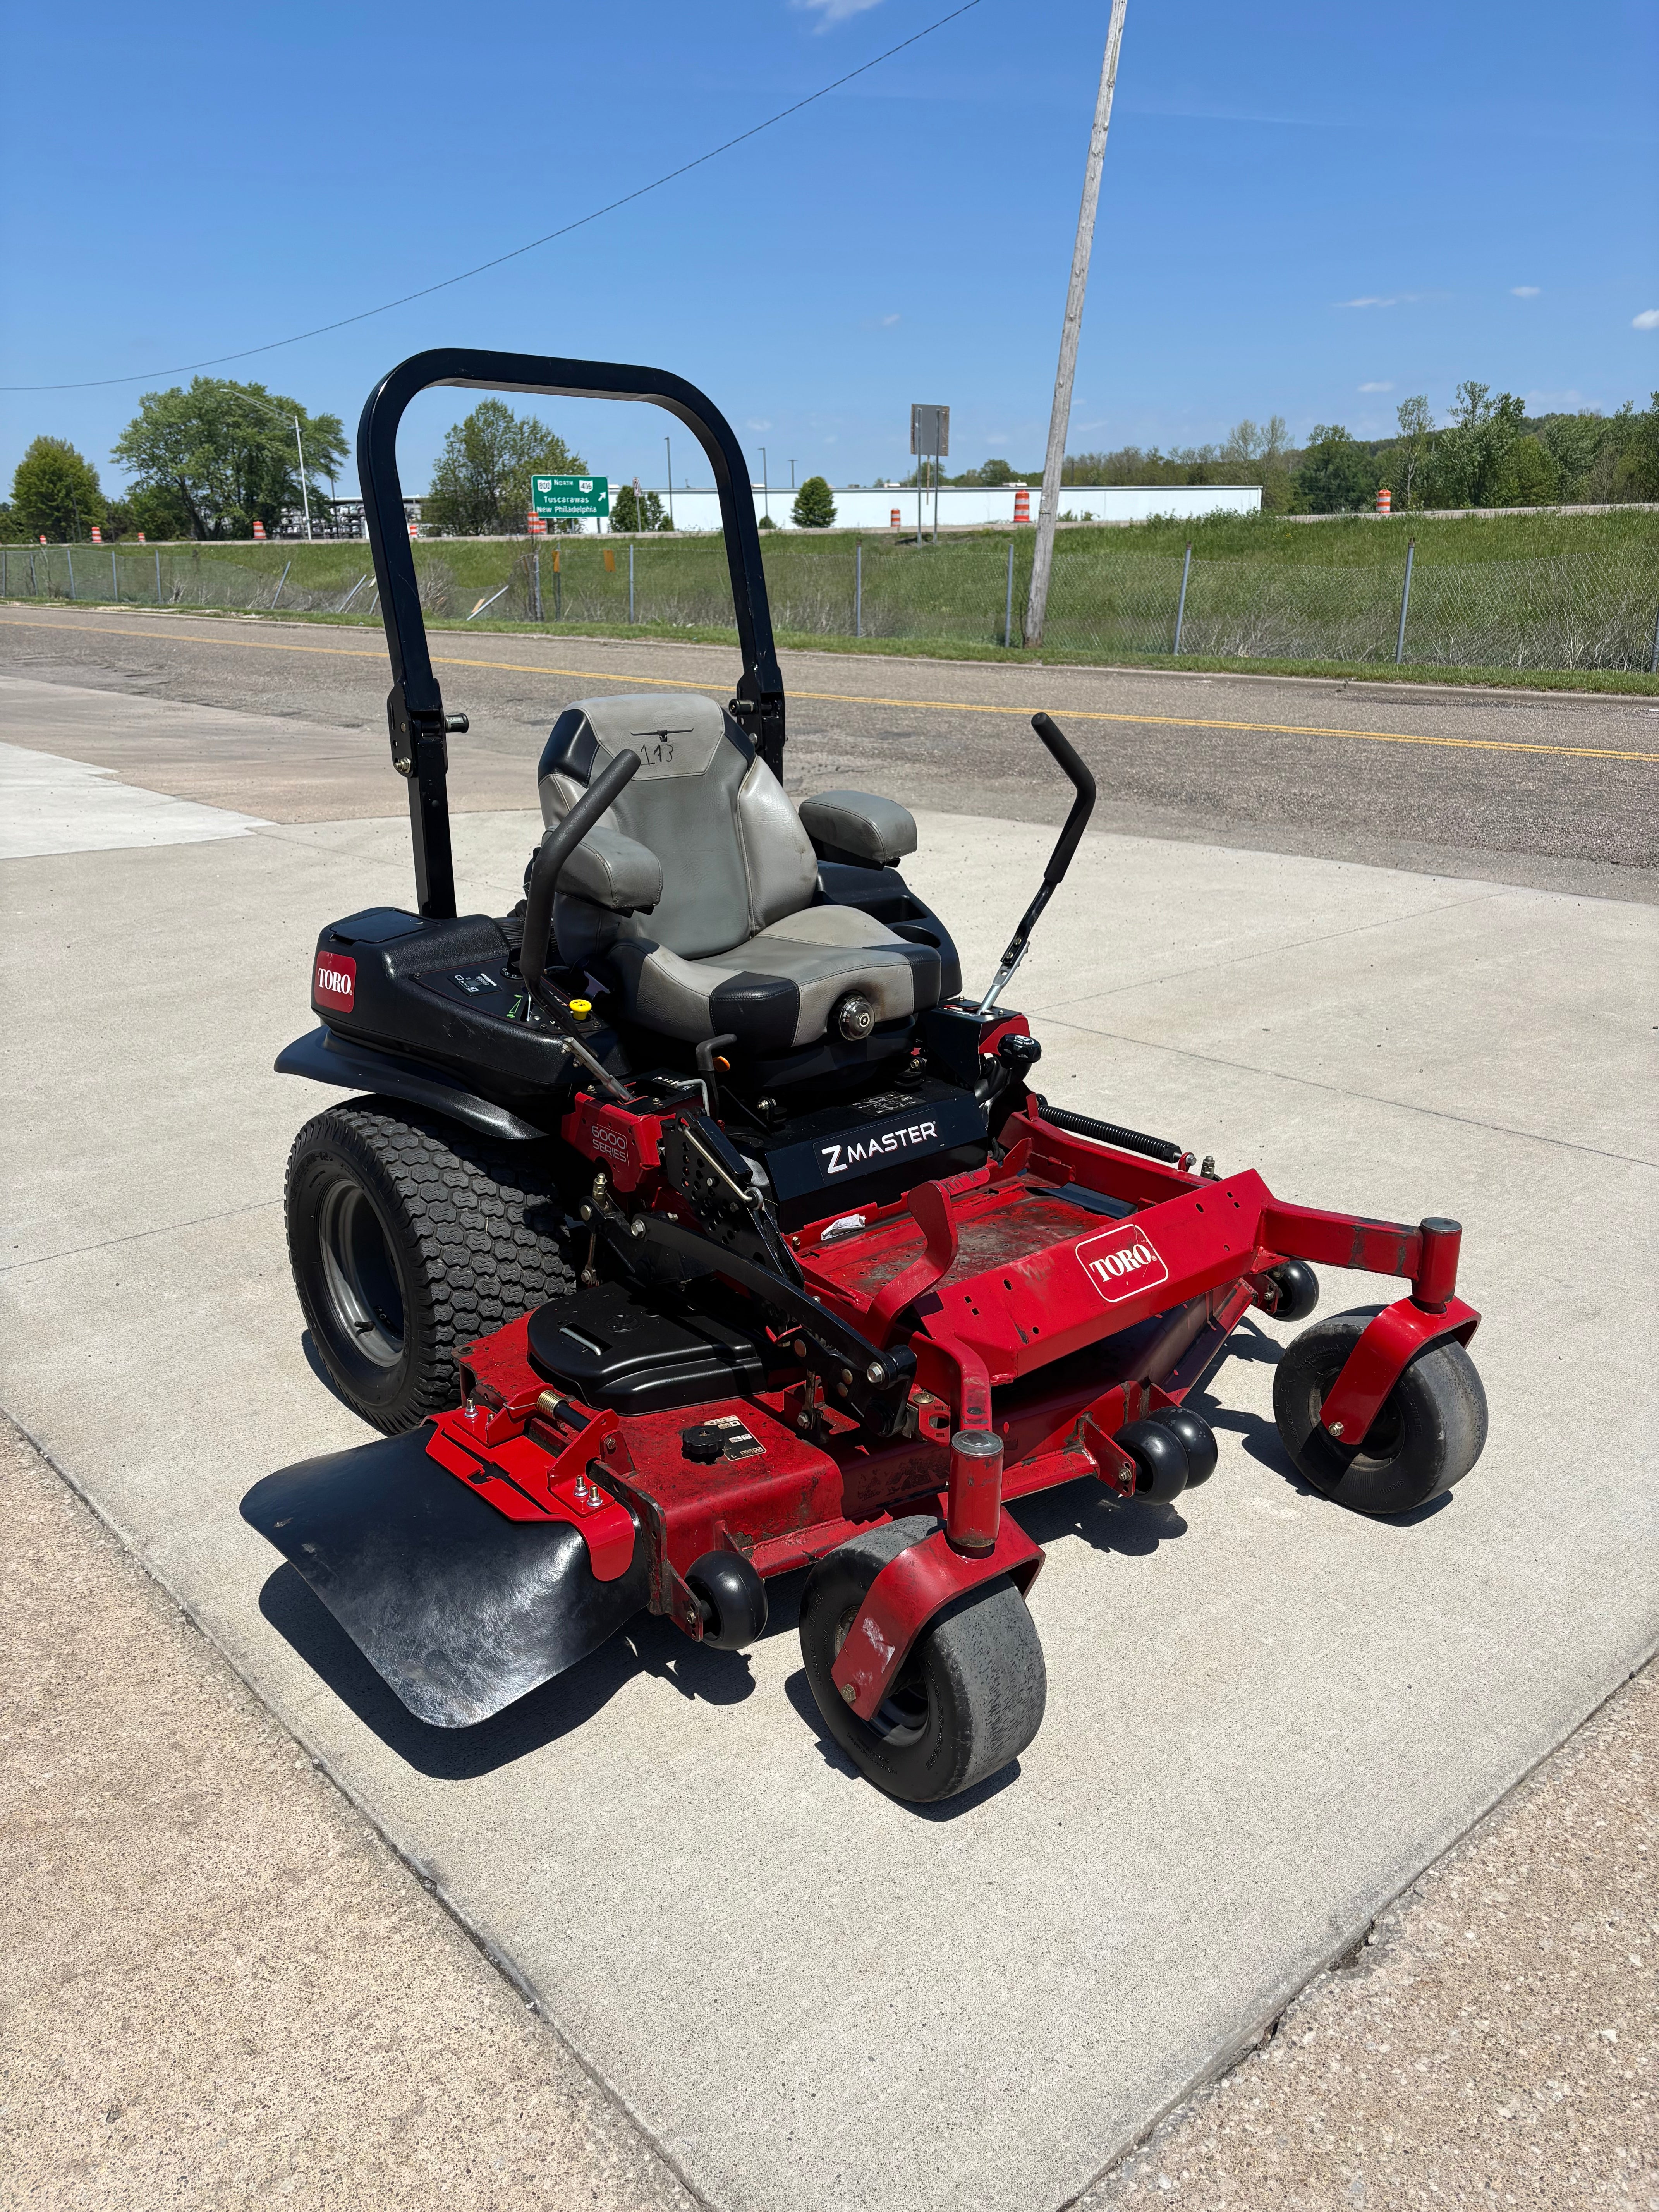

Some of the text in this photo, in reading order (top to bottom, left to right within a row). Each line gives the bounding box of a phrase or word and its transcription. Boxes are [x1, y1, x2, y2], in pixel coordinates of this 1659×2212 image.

[554, 506, 597, 514] Philadelphia
[318, 967, 351, 995] TORO
[591, 1125, 626, 1150] 6000
[592, 1139, 627, 1162] SERIES
[847, 1121, 938, 1164] MASTER
[1089, 1244, 1151, 1282] TORO
